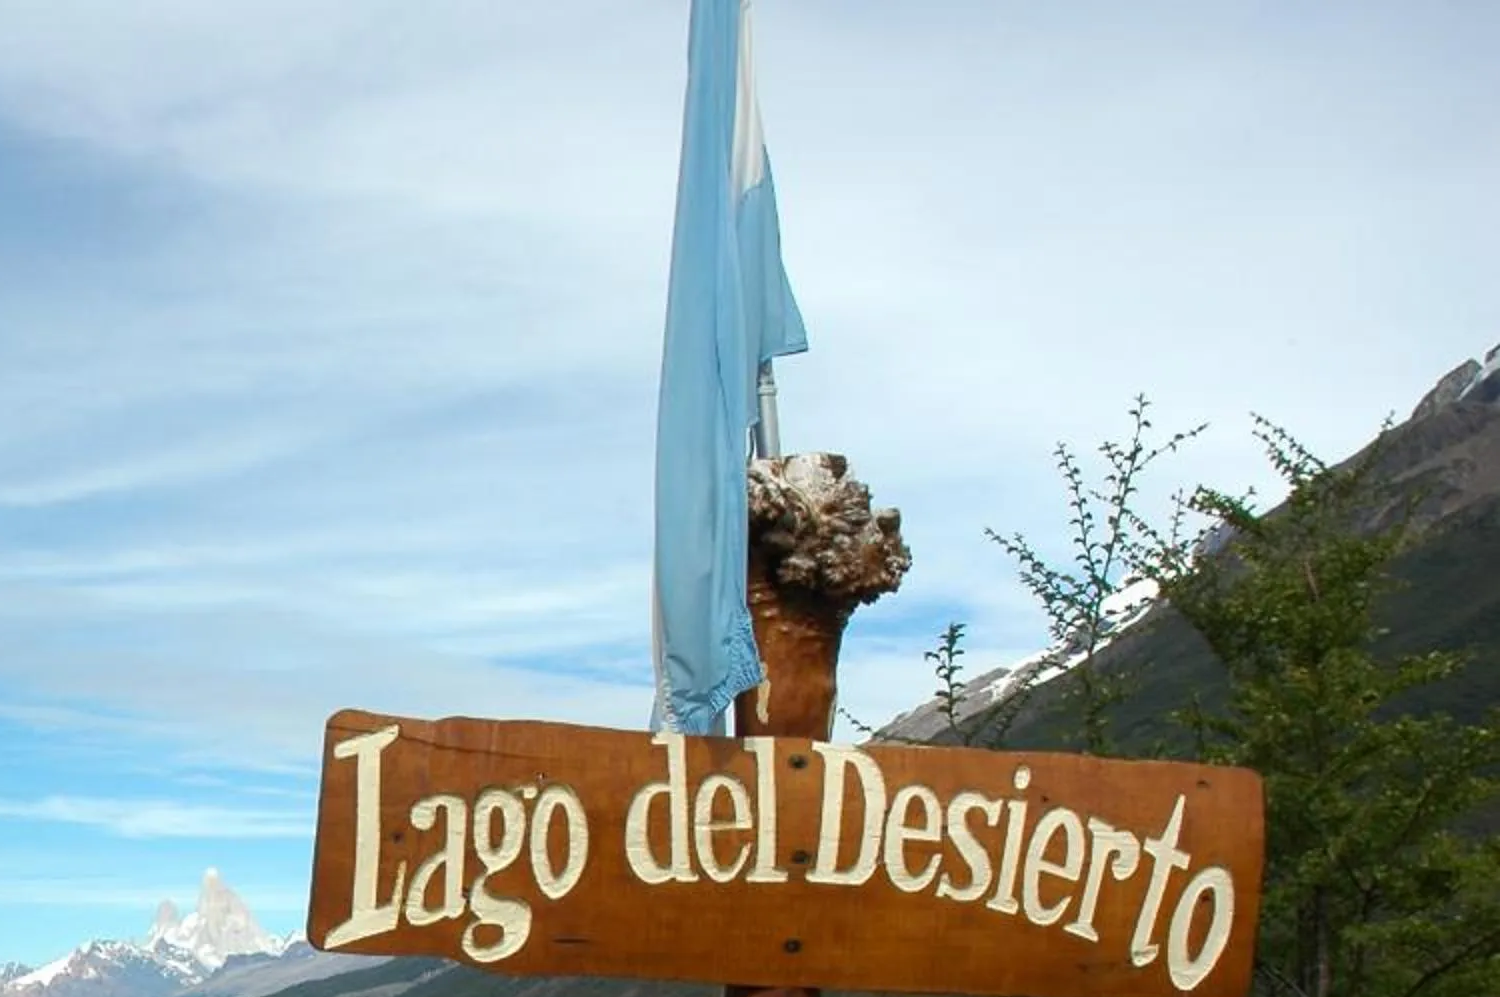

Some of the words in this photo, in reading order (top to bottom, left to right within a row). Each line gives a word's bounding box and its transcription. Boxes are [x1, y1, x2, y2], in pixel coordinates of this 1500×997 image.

[324, 724, 589, 963] Lago
[624, 733, 788, 884] del
[807, 741, 1235, 991] Desierto
